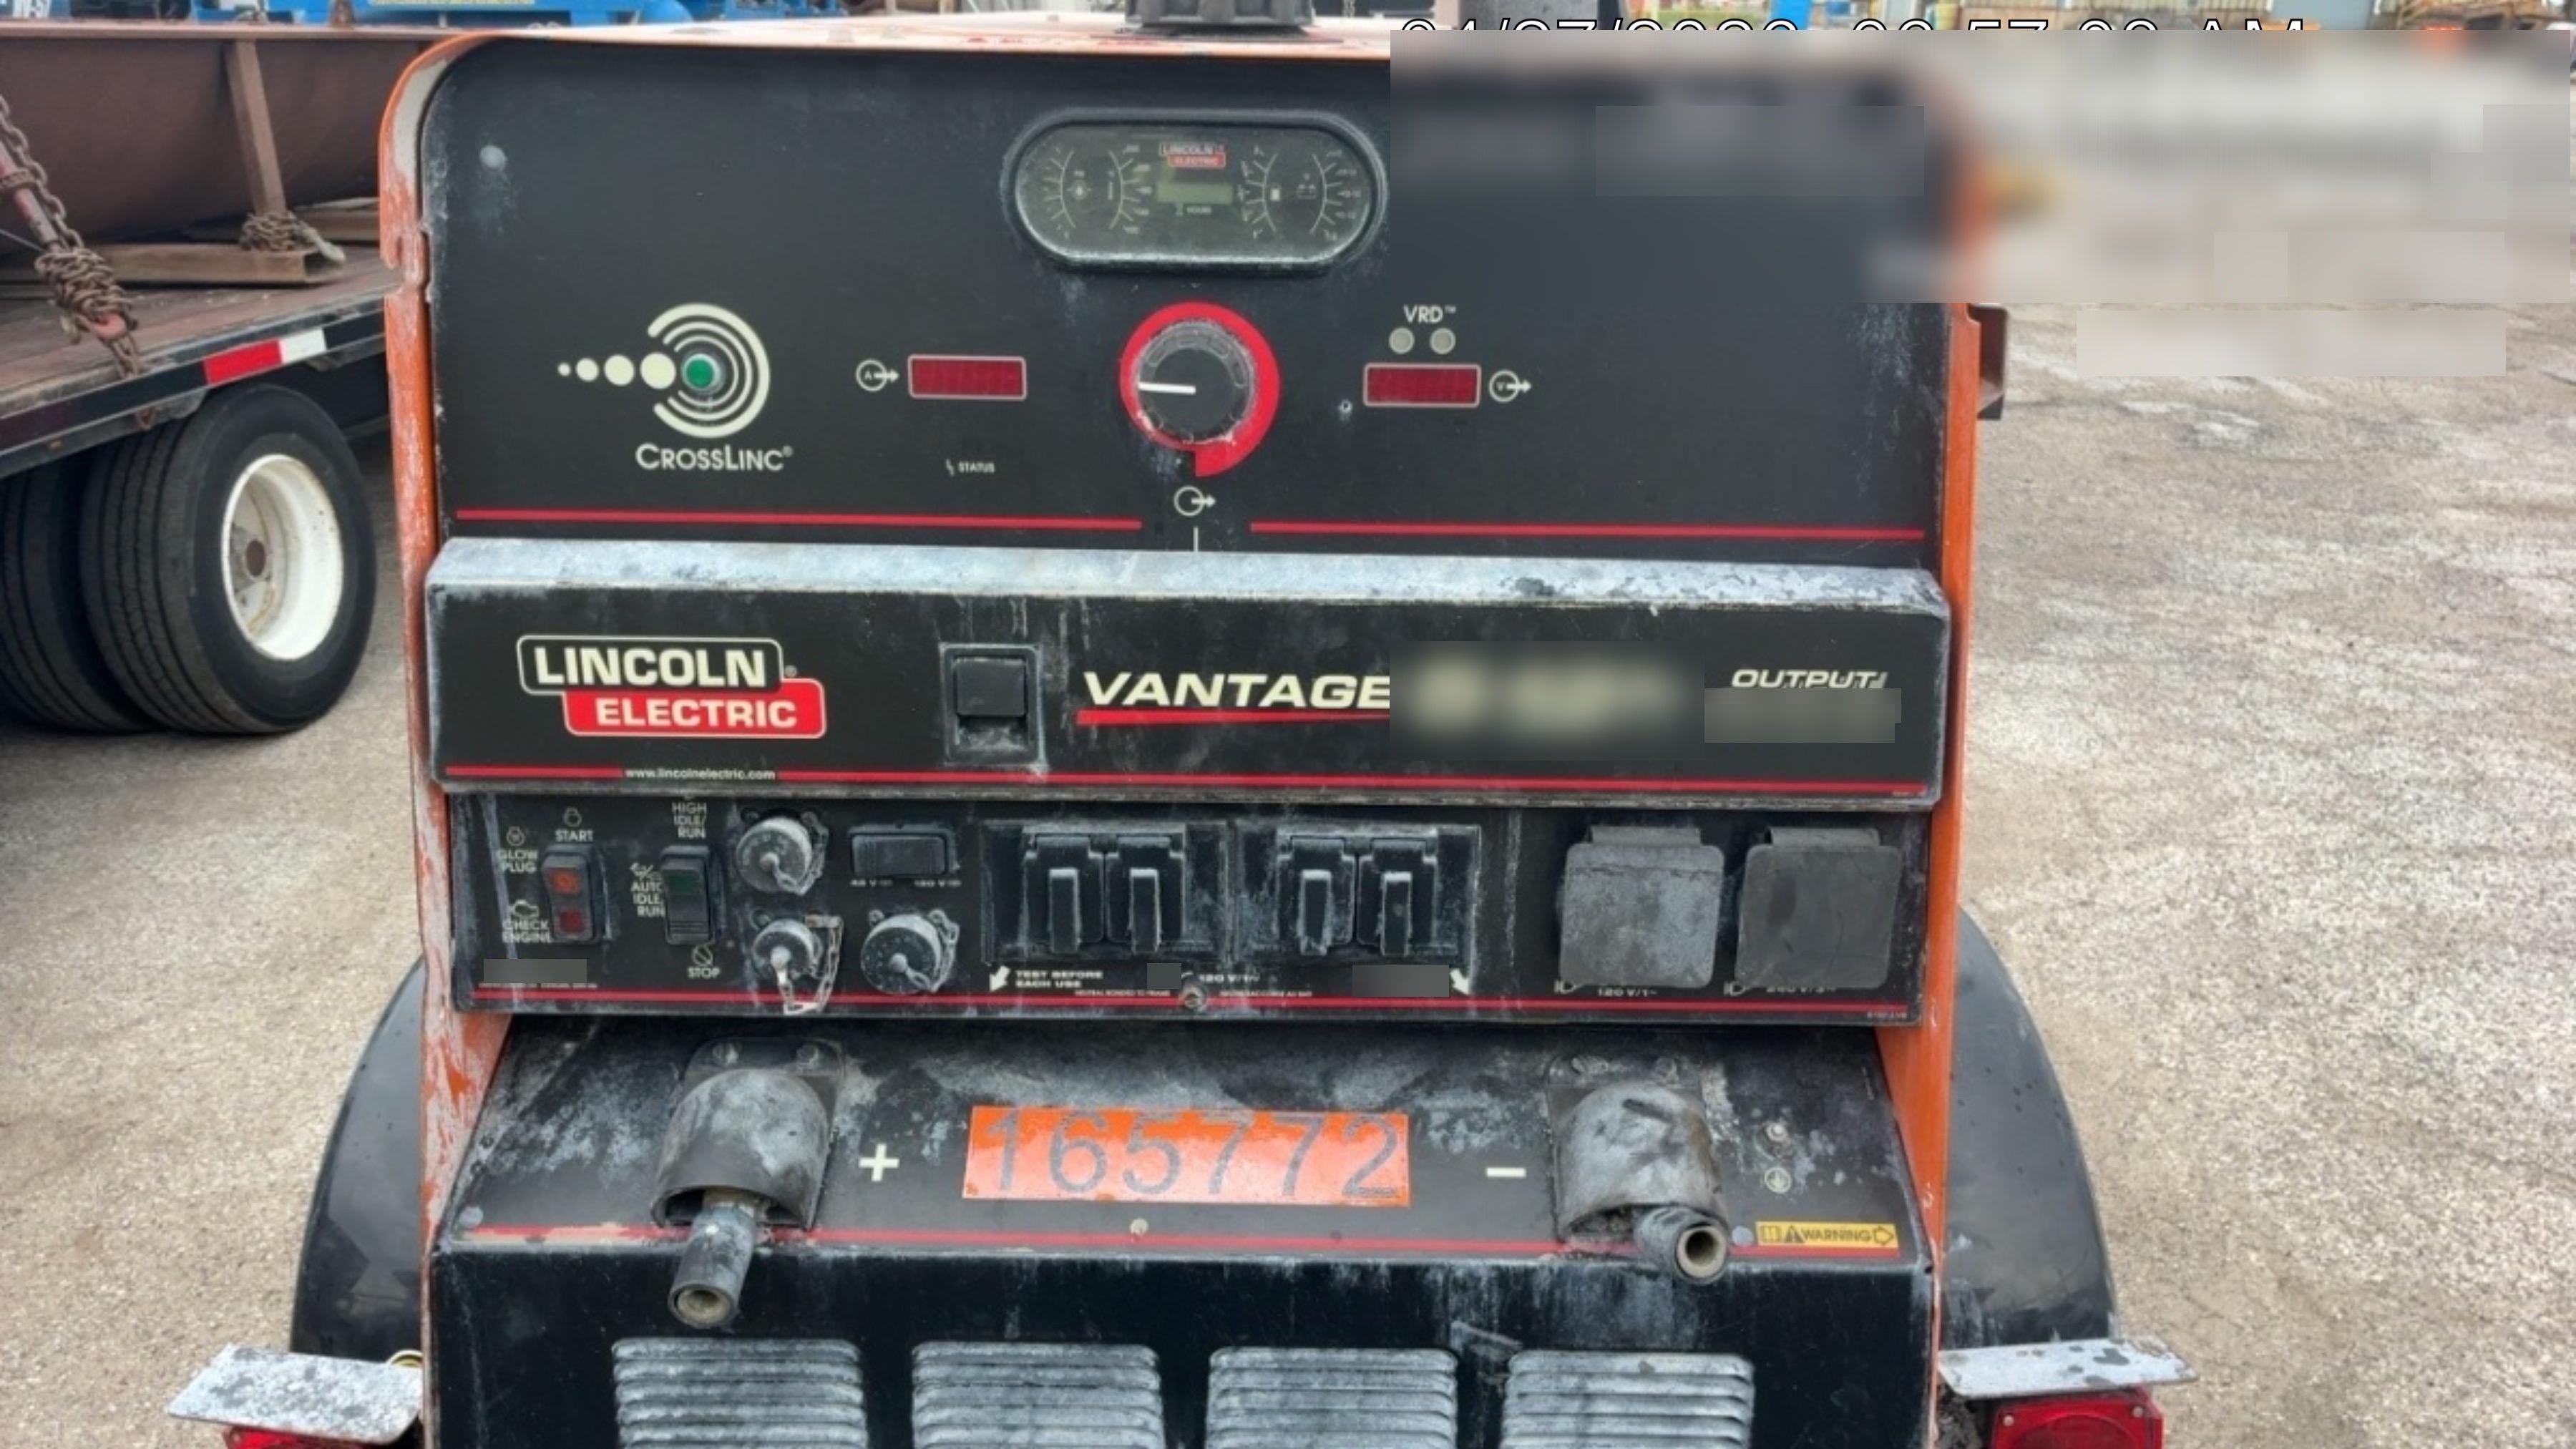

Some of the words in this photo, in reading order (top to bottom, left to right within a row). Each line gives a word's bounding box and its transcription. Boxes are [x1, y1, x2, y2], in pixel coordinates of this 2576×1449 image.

[958, 461, 995, 474] STATUS
[534, 646, 767, 688] LINCOLN
[1083, 670, 1390, 710] VANTAGE
[595, 697, 798, 729] ELECTRIC
[625, 767, 776, 780] www.lincolnelectric.com
[671, 801, 707, 814] HIGH
[555, 829, 594, 842] START
[678, 826, 706, 839] RUN
[496, 849, 538, 861] GLOW
[499, 861, 537, 873] PLUG
[637, 905, 665, 917] RUN
[502, 919, 550, 930] CHECK
[688, 967, 721, 979] STOP
[1050, 970, 1103, 980] BEFORE
[985, 1108, 1400, 1197] 165772
[1800, 1229, 1873, 1244] WARNING
